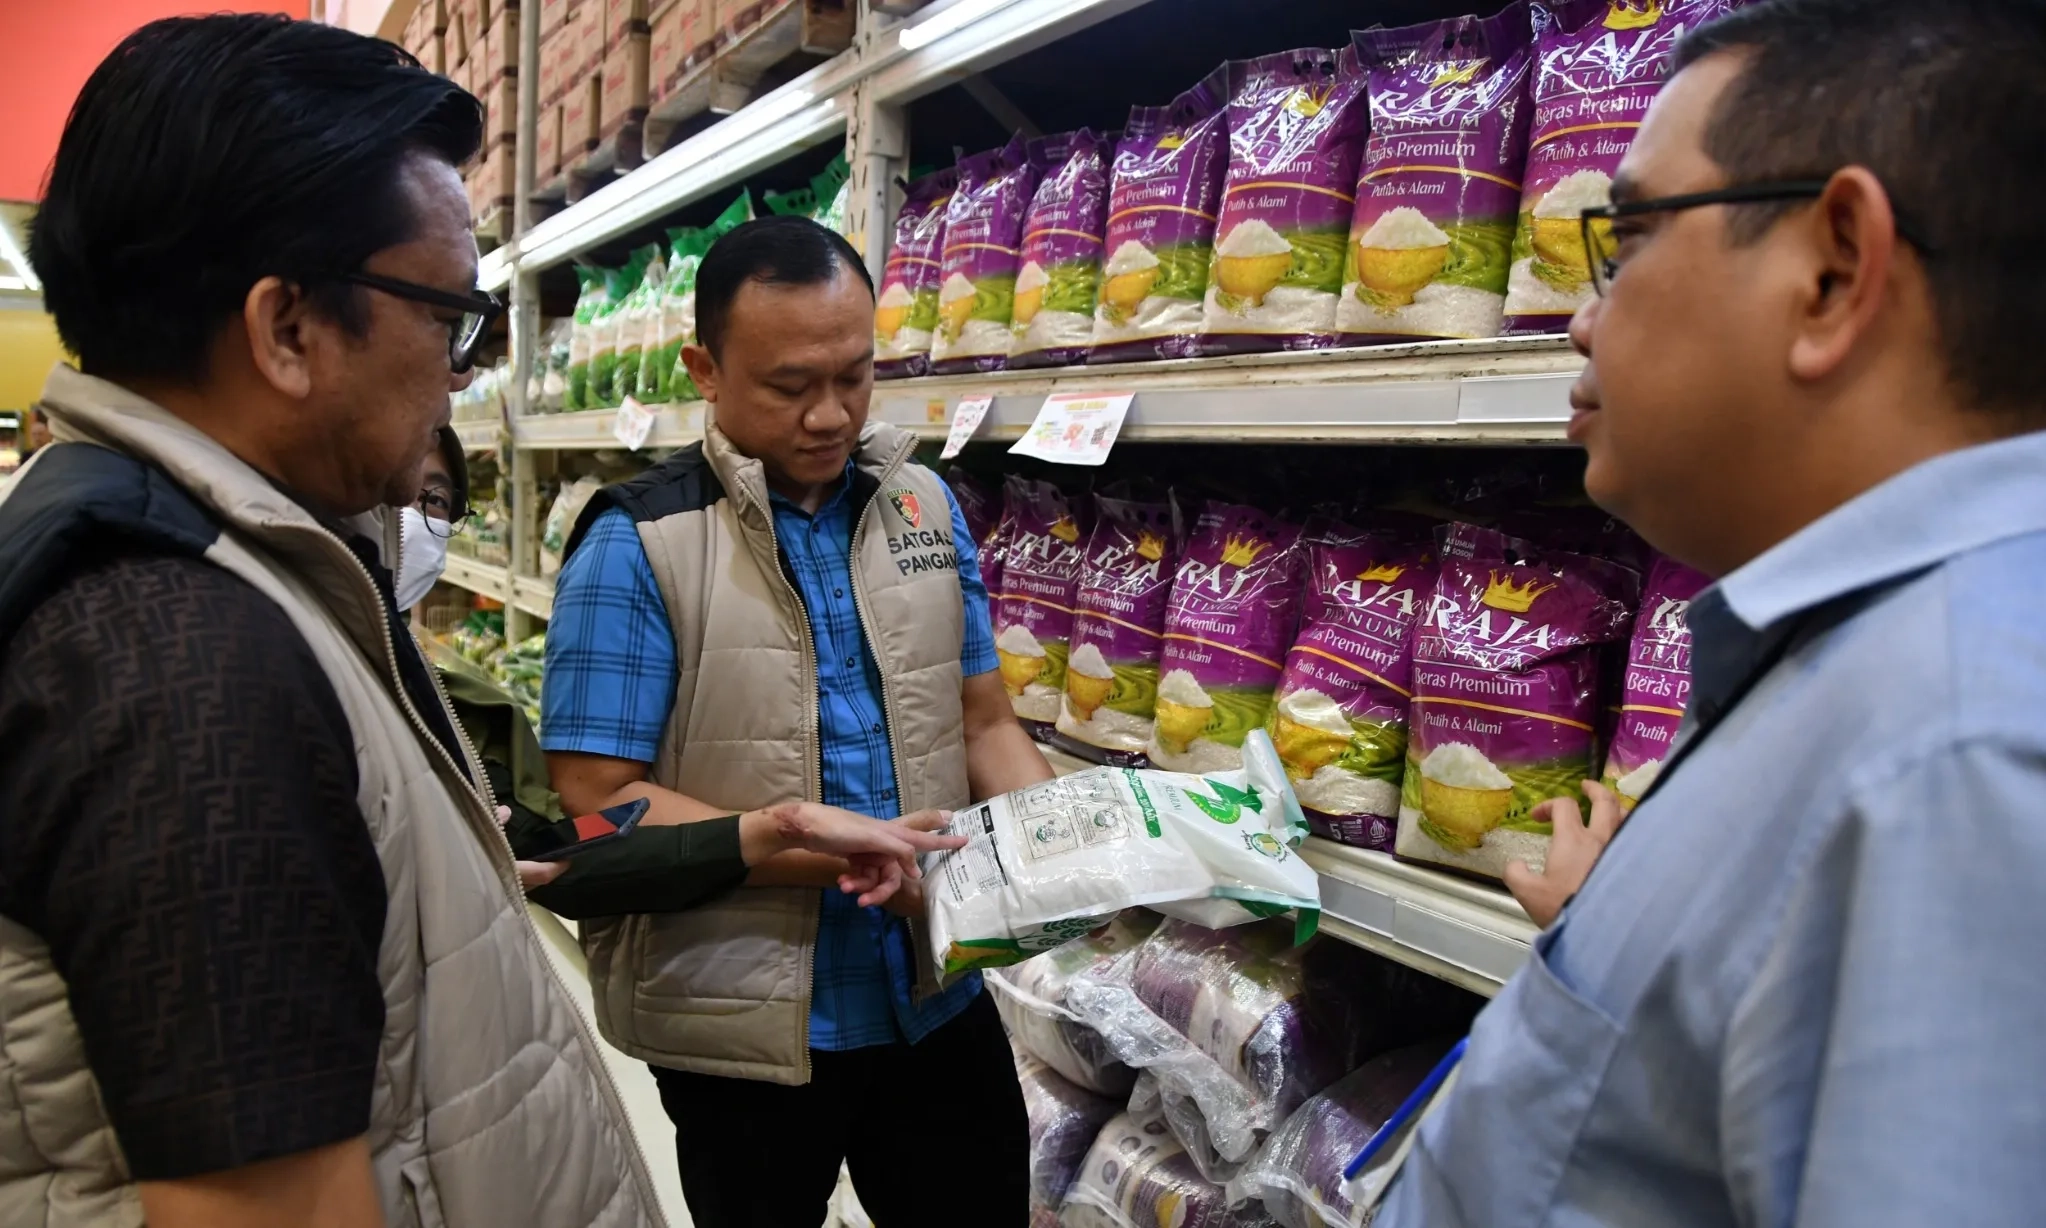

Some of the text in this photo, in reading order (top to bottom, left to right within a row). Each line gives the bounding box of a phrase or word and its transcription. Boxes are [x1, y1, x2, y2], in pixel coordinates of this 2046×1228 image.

[1535, 92, 1656, 126] Beras Premiu
[1397, 139, 1476, 158] Premium
[1544, 138, 1630, 161] Putih & Alam
[1126, 183, 1176, 203] Premium
[1371, 181, 1447, 198] Putih & Alami
[1247, 197, 1255, 209] &
[1256, 195, 1288, 208] Alami
[1019, 577, 1065, 597] Premium
[1092, 592, 1135, 613] Premium
[1180, 616, 1236, 635] Premium
[1422, 594, 1552, 651] RAJA
[1186, 648, 1213, 664] Alami
[1324, 628, 1396, 667] Premium
[1295, 658, 1359, 691] Putih & Alami
[1414, 667, 1531, 697] Beras Premium
[1627, 672, 1672, 698] Beras
[1424, 711, 1503, 735] Putih & Alami
[1633, 721, 1668, 742] Putih
[1328, 823, 1342, 840] 5
